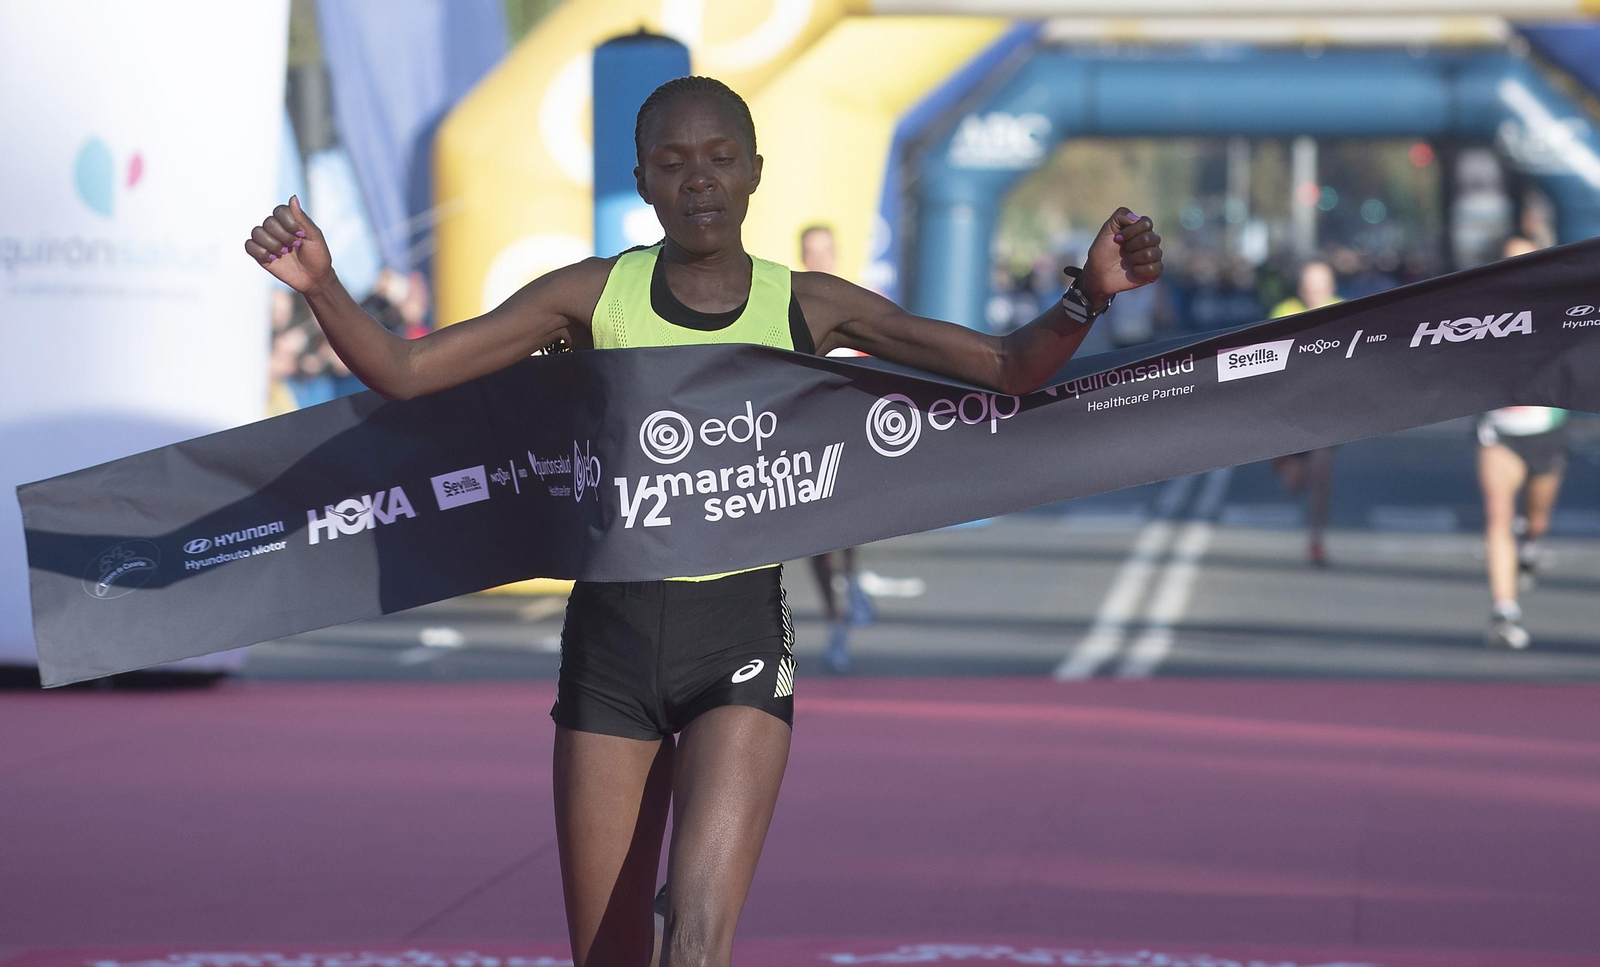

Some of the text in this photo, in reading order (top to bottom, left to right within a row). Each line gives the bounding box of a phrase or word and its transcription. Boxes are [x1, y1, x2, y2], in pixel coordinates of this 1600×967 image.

[1366, 334, 1388, 343] IMD
[1409, 310, 1533, 349] HOKA
[1087, 384, 1195, 412] Healthcare Partner
[699, 400, 778, 451] edp
[657, 450, 813, 497] maratón
[306, 485, 417, 546] HOKA
[704, 474, 817, 522] sevilla
[214, 520, 285, 547] HYUNDAI
[184, 540, 288, 570] Hyundauto Motor
